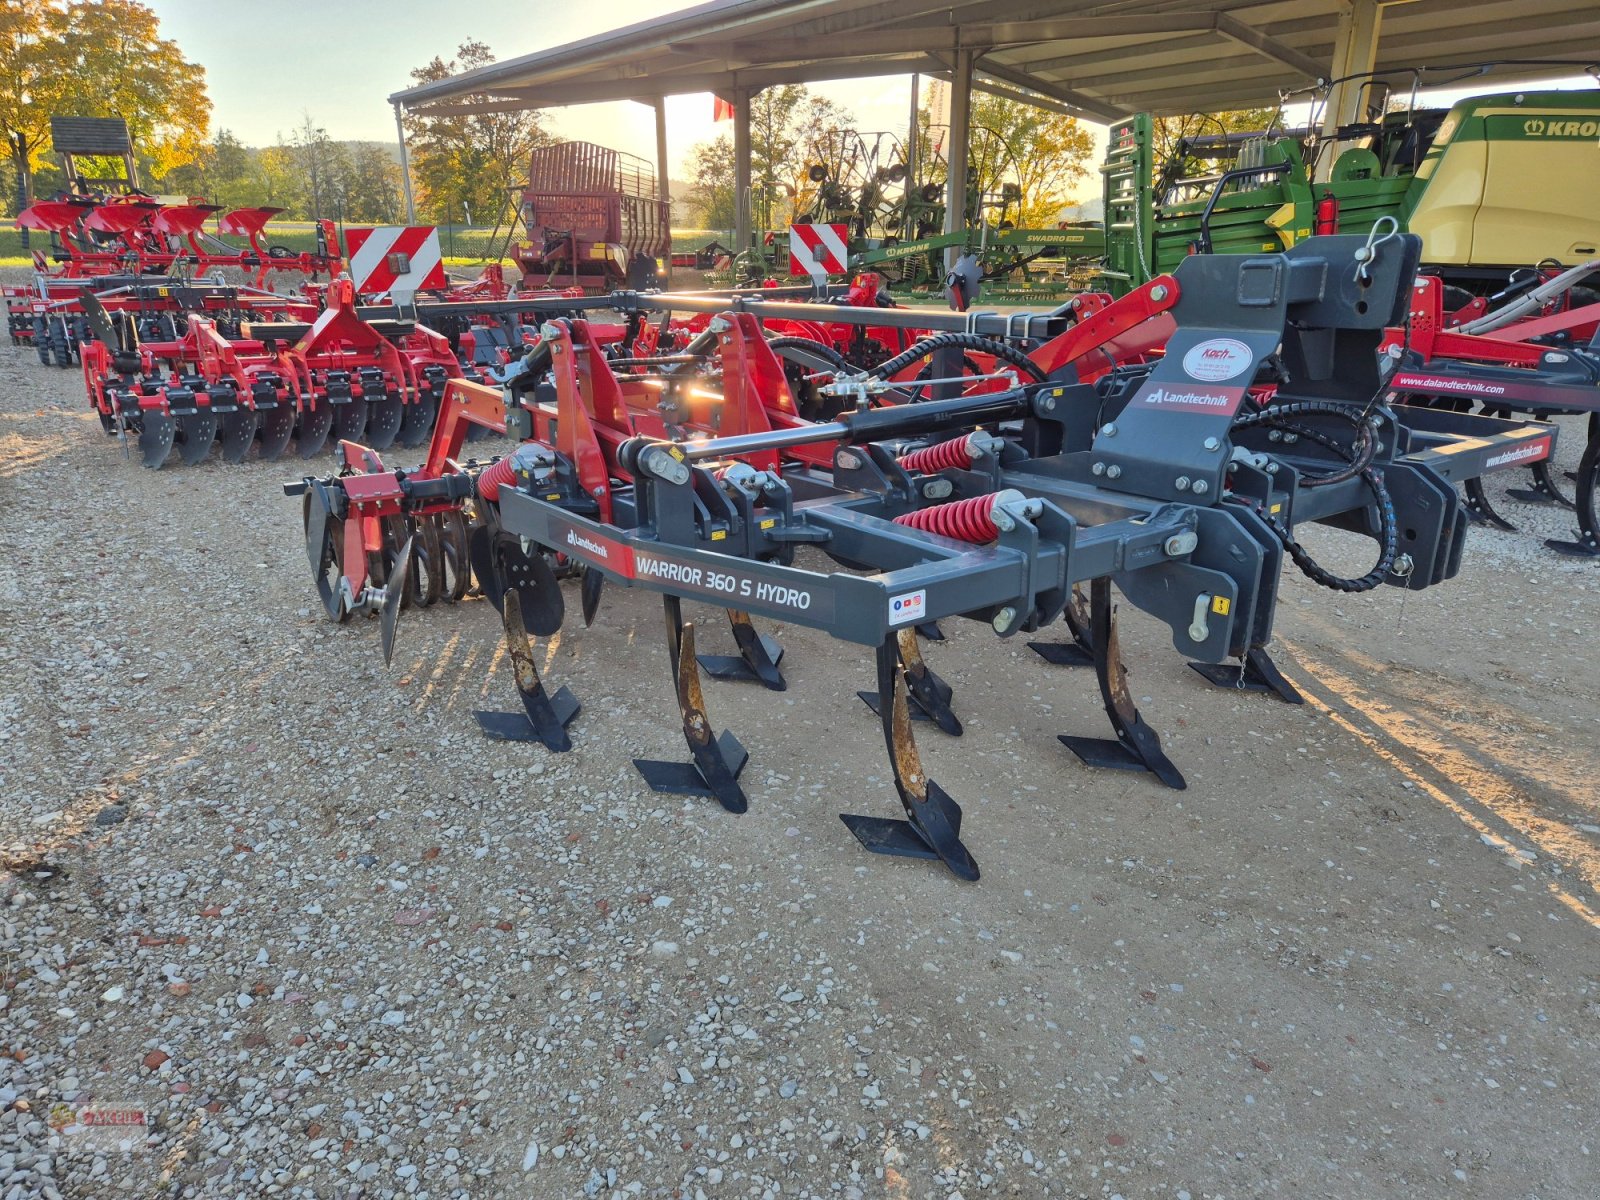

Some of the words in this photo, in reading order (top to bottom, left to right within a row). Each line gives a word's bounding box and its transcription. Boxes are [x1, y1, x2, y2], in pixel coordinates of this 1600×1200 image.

[1546, 121, 1600, 137] KRO
[896, 242, 930, 256] KRONE
[1400, 376, 1504, 394] www.dalandtechnik.com
[1163, 391, 1228, 406] Landtechnik
[575, 533, 608, 558] Landtechnik
[636, 556, 702, 586] WARRIOR
[705, 571, 736, 593] 360
[740, 579, 751, 597] S
[756, 582, 811, 610] HYDRO
